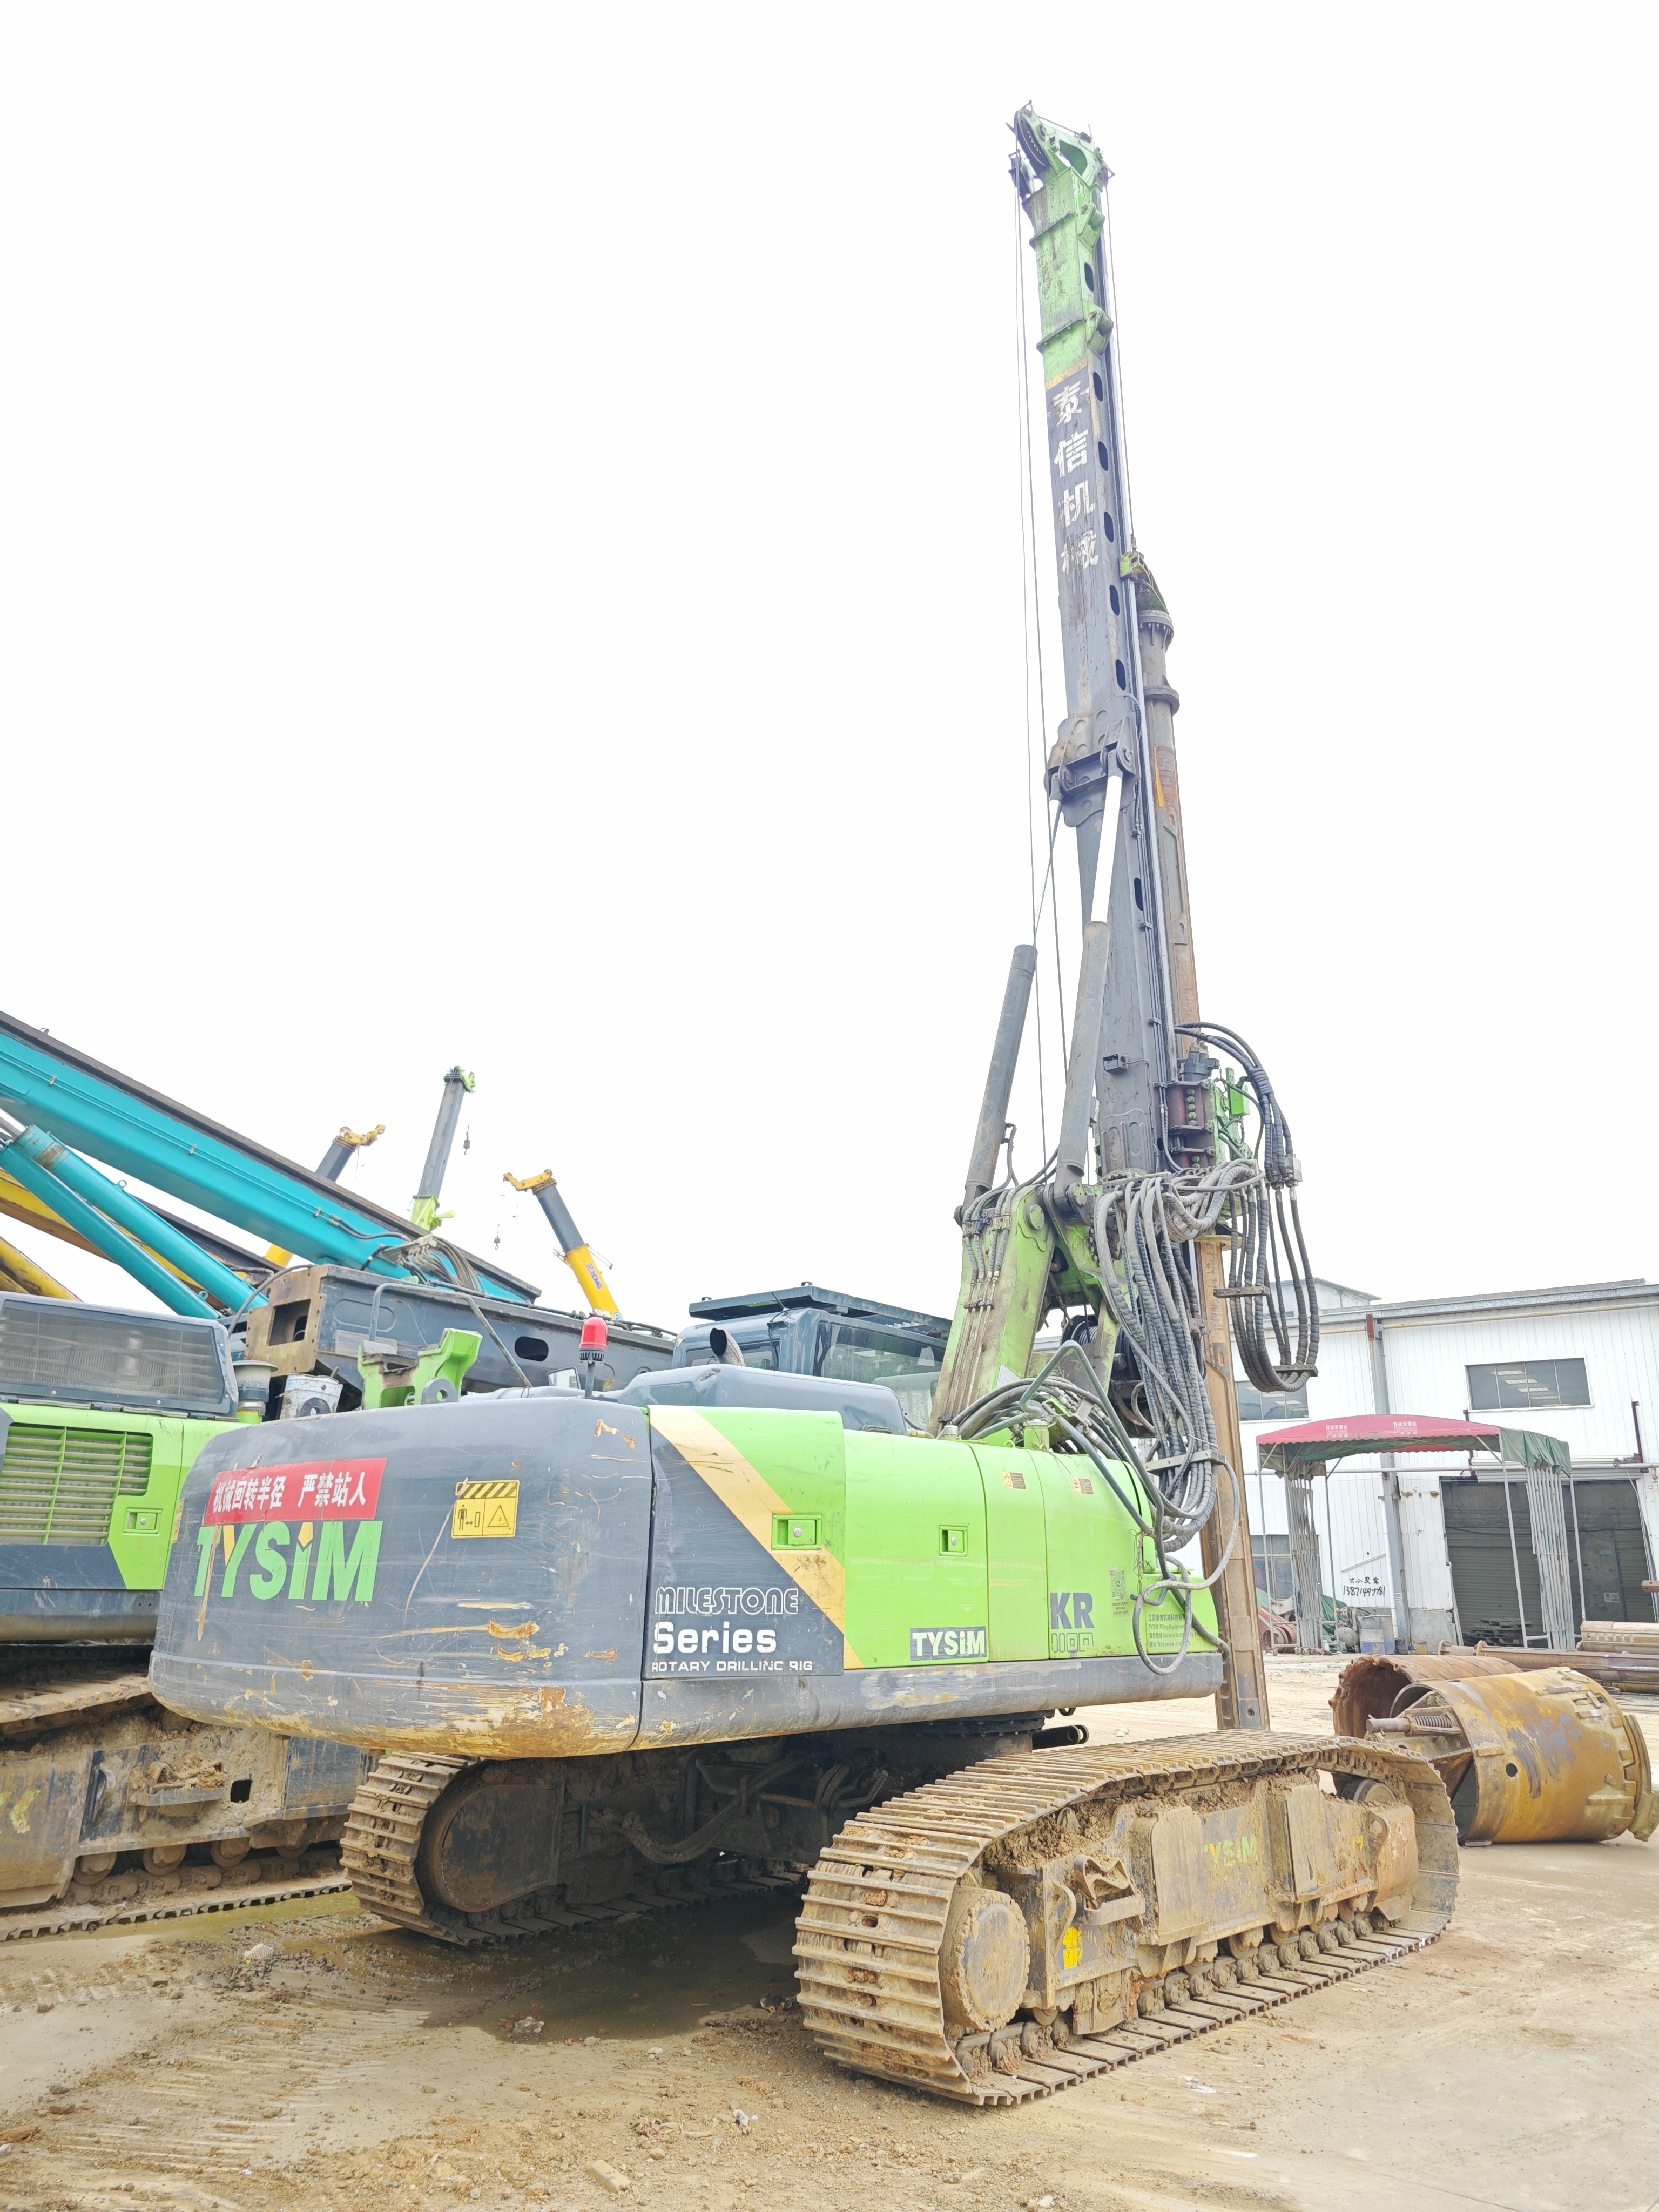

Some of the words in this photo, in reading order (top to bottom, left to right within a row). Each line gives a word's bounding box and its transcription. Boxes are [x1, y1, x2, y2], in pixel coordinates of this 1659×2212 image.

[1053, 380, 1100, 575] 泰信机械
[212, 1475, 287, 1514] 机械回转半径
[297, 1471, 367, 1508] 严禁站人
[1343, 1584, 1385, 1597] 13871497781
[1349, 1576, 1380, 1586] 大小叉车
[655, 1587, 799, 1615] MILESTONE
[1050, 1592, 1095, 1629] KR
[653, 1621, 777, 1654] Series
[651, 1661, 711, 1672] ROTARY
[788, 1660, 813, 1671] RIG
